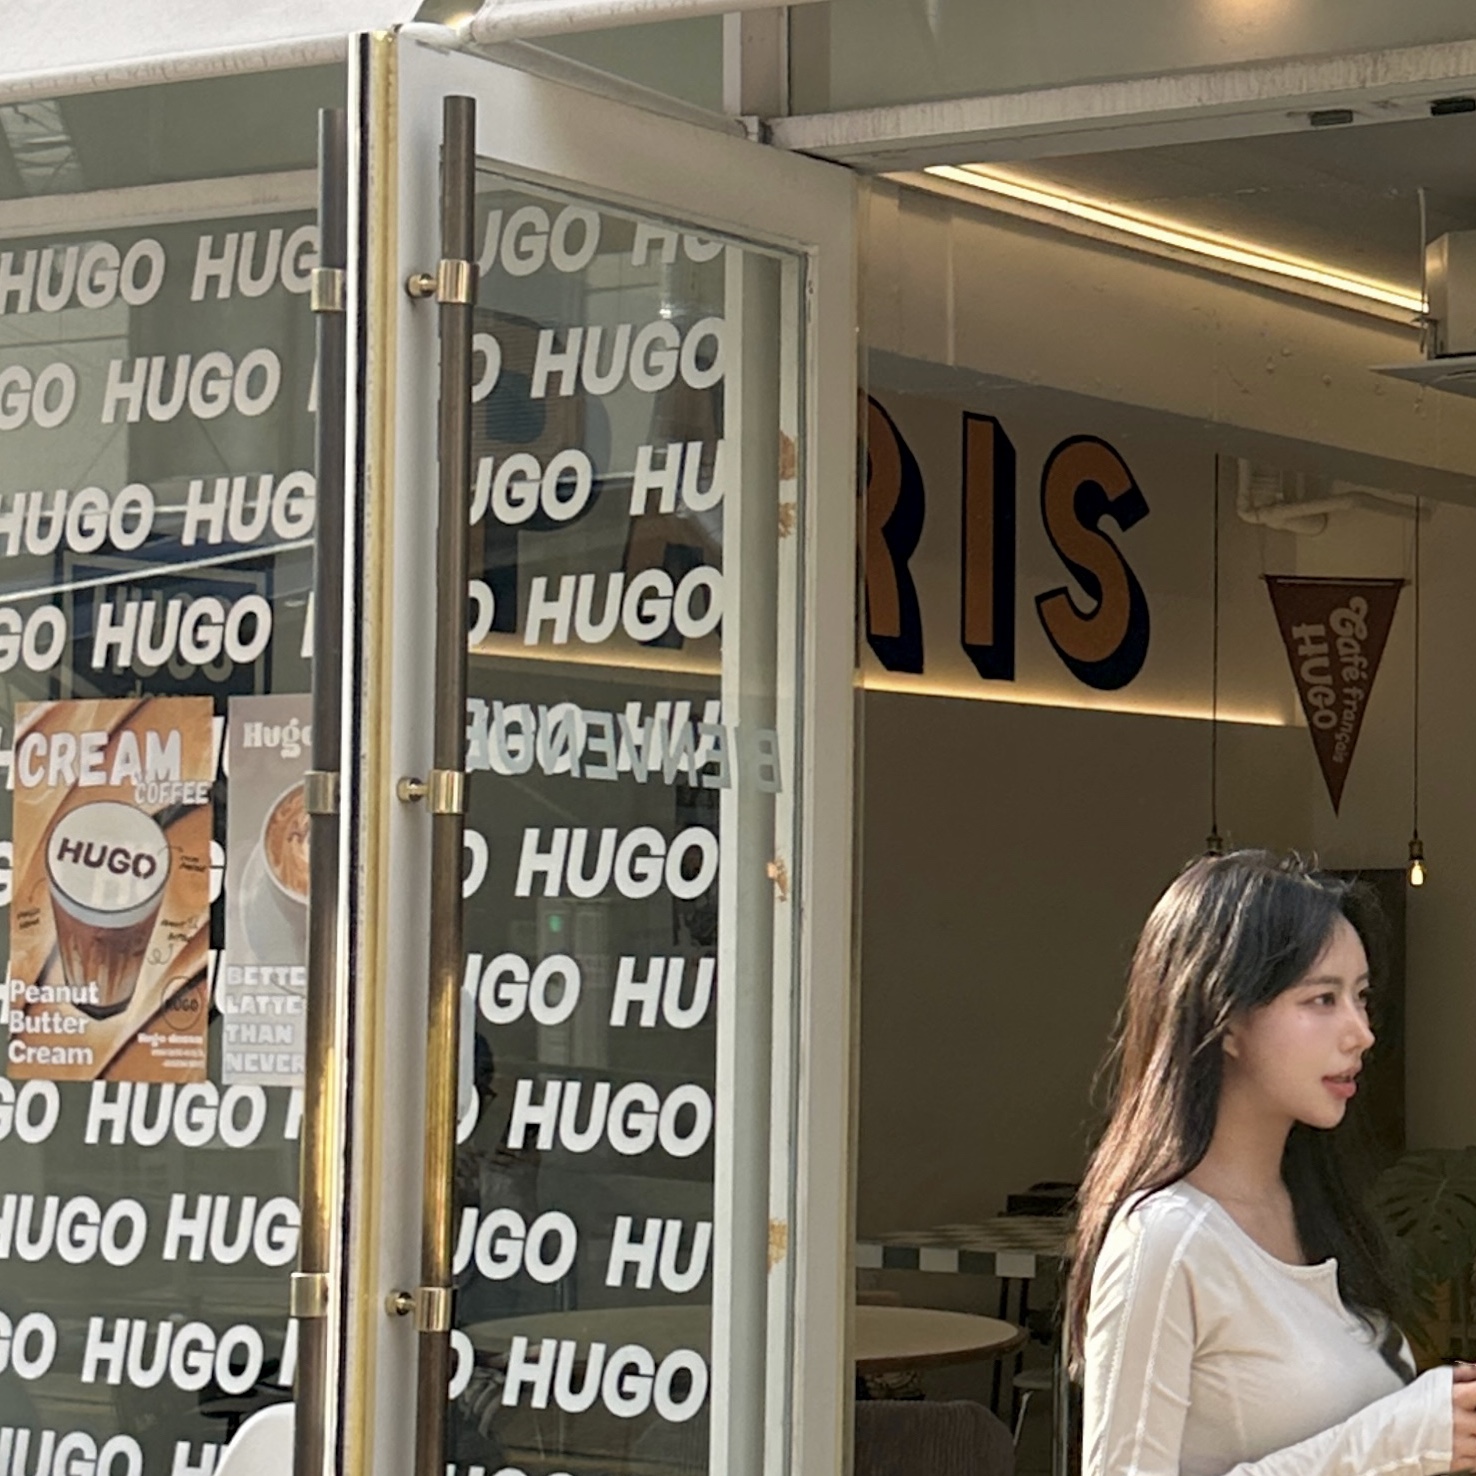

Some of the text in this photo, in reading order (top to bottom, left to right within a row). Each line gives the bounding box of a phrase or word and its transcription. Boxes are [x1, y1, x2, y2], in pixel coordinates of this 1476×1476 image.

[0, 225, 319, 314] HUGO HUG
[0, 348, 281, 430] GO HUGO
[531, 317, 725, 397] HUGO
[181, 470, 316, 546] HUG
[629, 439, 724, 515] HU
[91, 594, 272, 669] HUGO
[524, 566, 724, 646] HUGO
[1292, 623, 1338, 729] HUGO
[17, 729, 182, 787] CREAM
[134, 780, 210, 806] COFFEE
[57, 838, 156, 880] HUGO
[515, 826, 720, 900] HUGO
[10, 979, 99, 1004] Peanut
[226, 966, 306, 986] BETTE
[226, 995, 303, 1015] LATTE
[610, 956, 716, 1029] HU
[8, 1040, 94, 1065] Cream
[9, 1009, 89, 1035] Butter
[225, 1024, 293, 1044] THAN
[85, 1081, 267, 1147] HUGO
[507, 1079, 714, 1158] HUGO
[162, 1193, 301, 1266] HUG
[606, 1216, 713, 1293] HU
[81, 1317, 264, 1394] HUGO
[501, 1336, 709, 1423] HUGO
